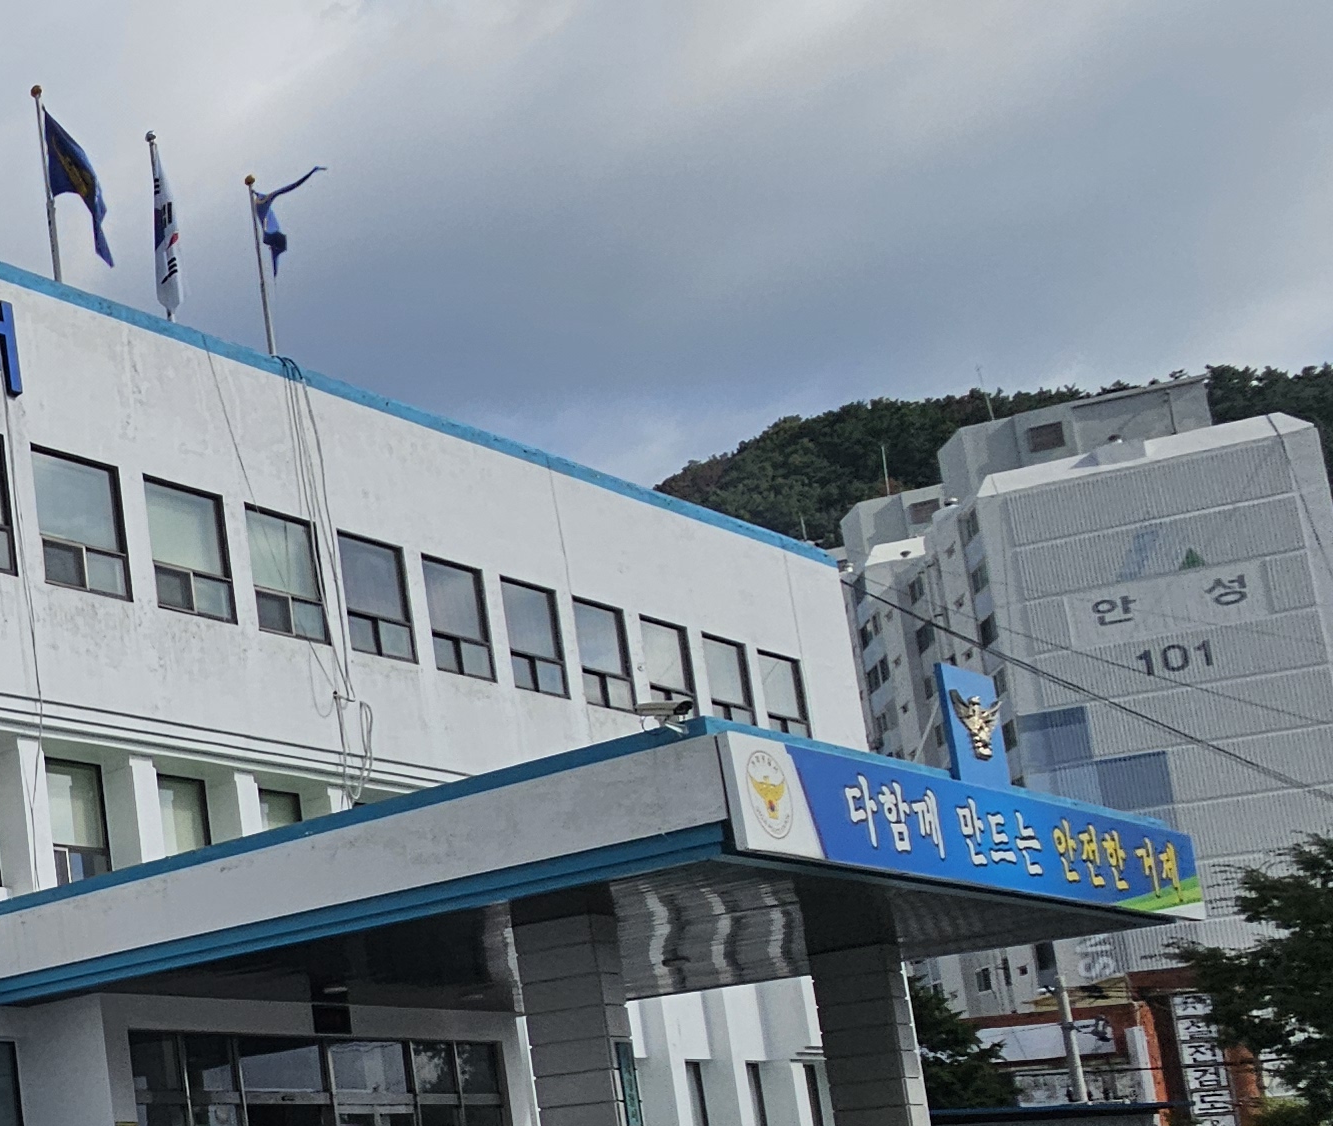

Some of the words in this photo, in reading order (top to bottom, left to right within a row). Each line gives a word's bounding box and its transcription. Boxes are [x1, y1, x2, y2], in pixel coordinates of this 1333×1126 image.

[1136, 639, 1214, 676] 101
[844, 774, 945, 860] 다함께
[957, 798, 1042, 875] 만드는
[1053, 819, 1130, 892] 안전한
[1135, 837, 1183, 902] 거제
